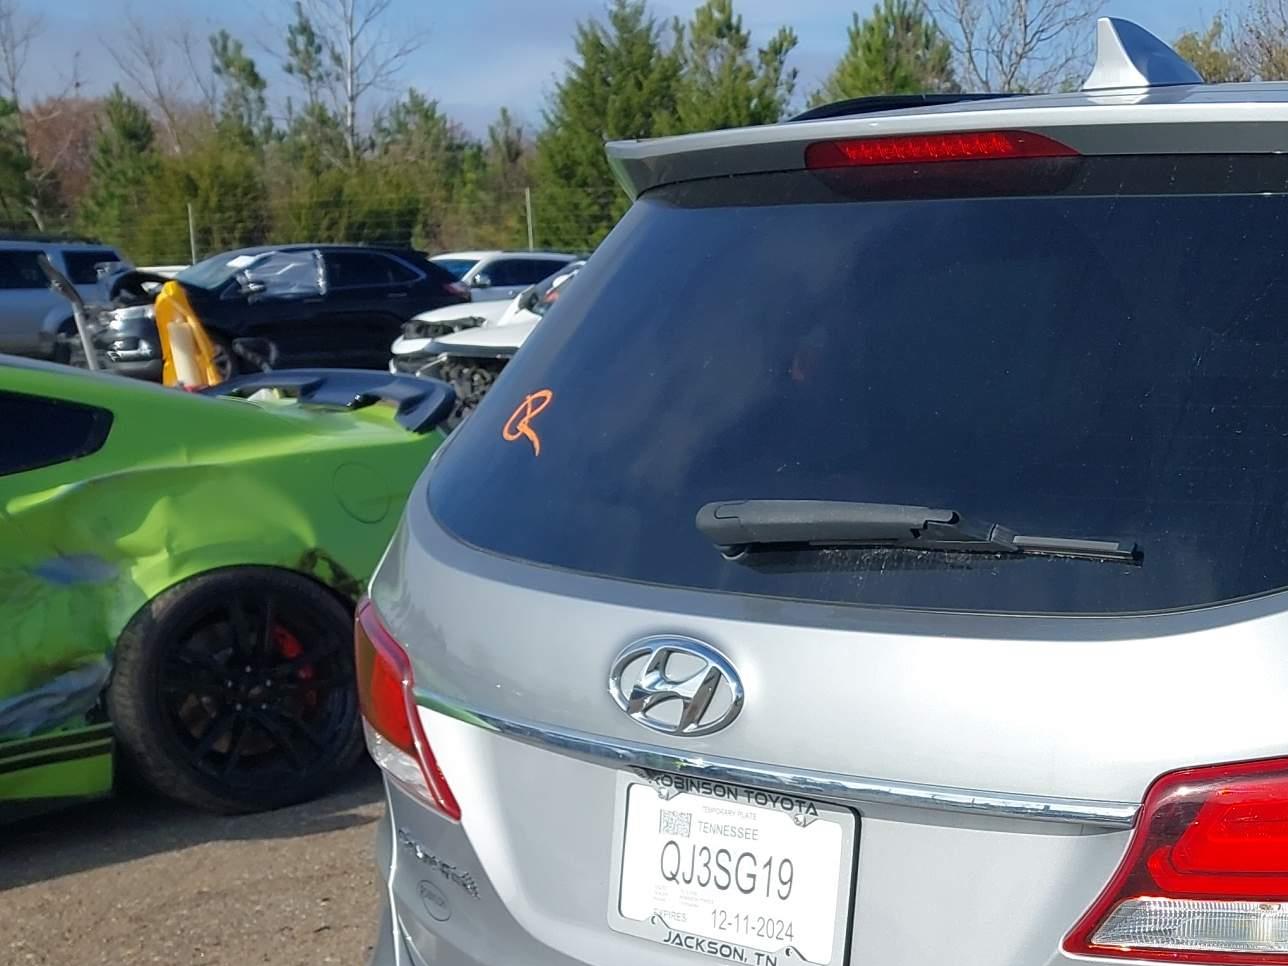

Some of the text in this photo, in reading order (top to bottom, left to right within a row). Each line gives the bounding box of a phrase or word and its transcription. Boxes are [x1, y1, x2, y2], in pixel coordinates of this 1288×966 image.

[743, 789, 819, 816] TOYOTA
[697, 820, 760, 841] TENNESSEE
[660, 840, 795, 901] QJ3SG19
[711, 908, 795, 943] 12-11-2024
[663, 930, 748, 963] JACKSON,
